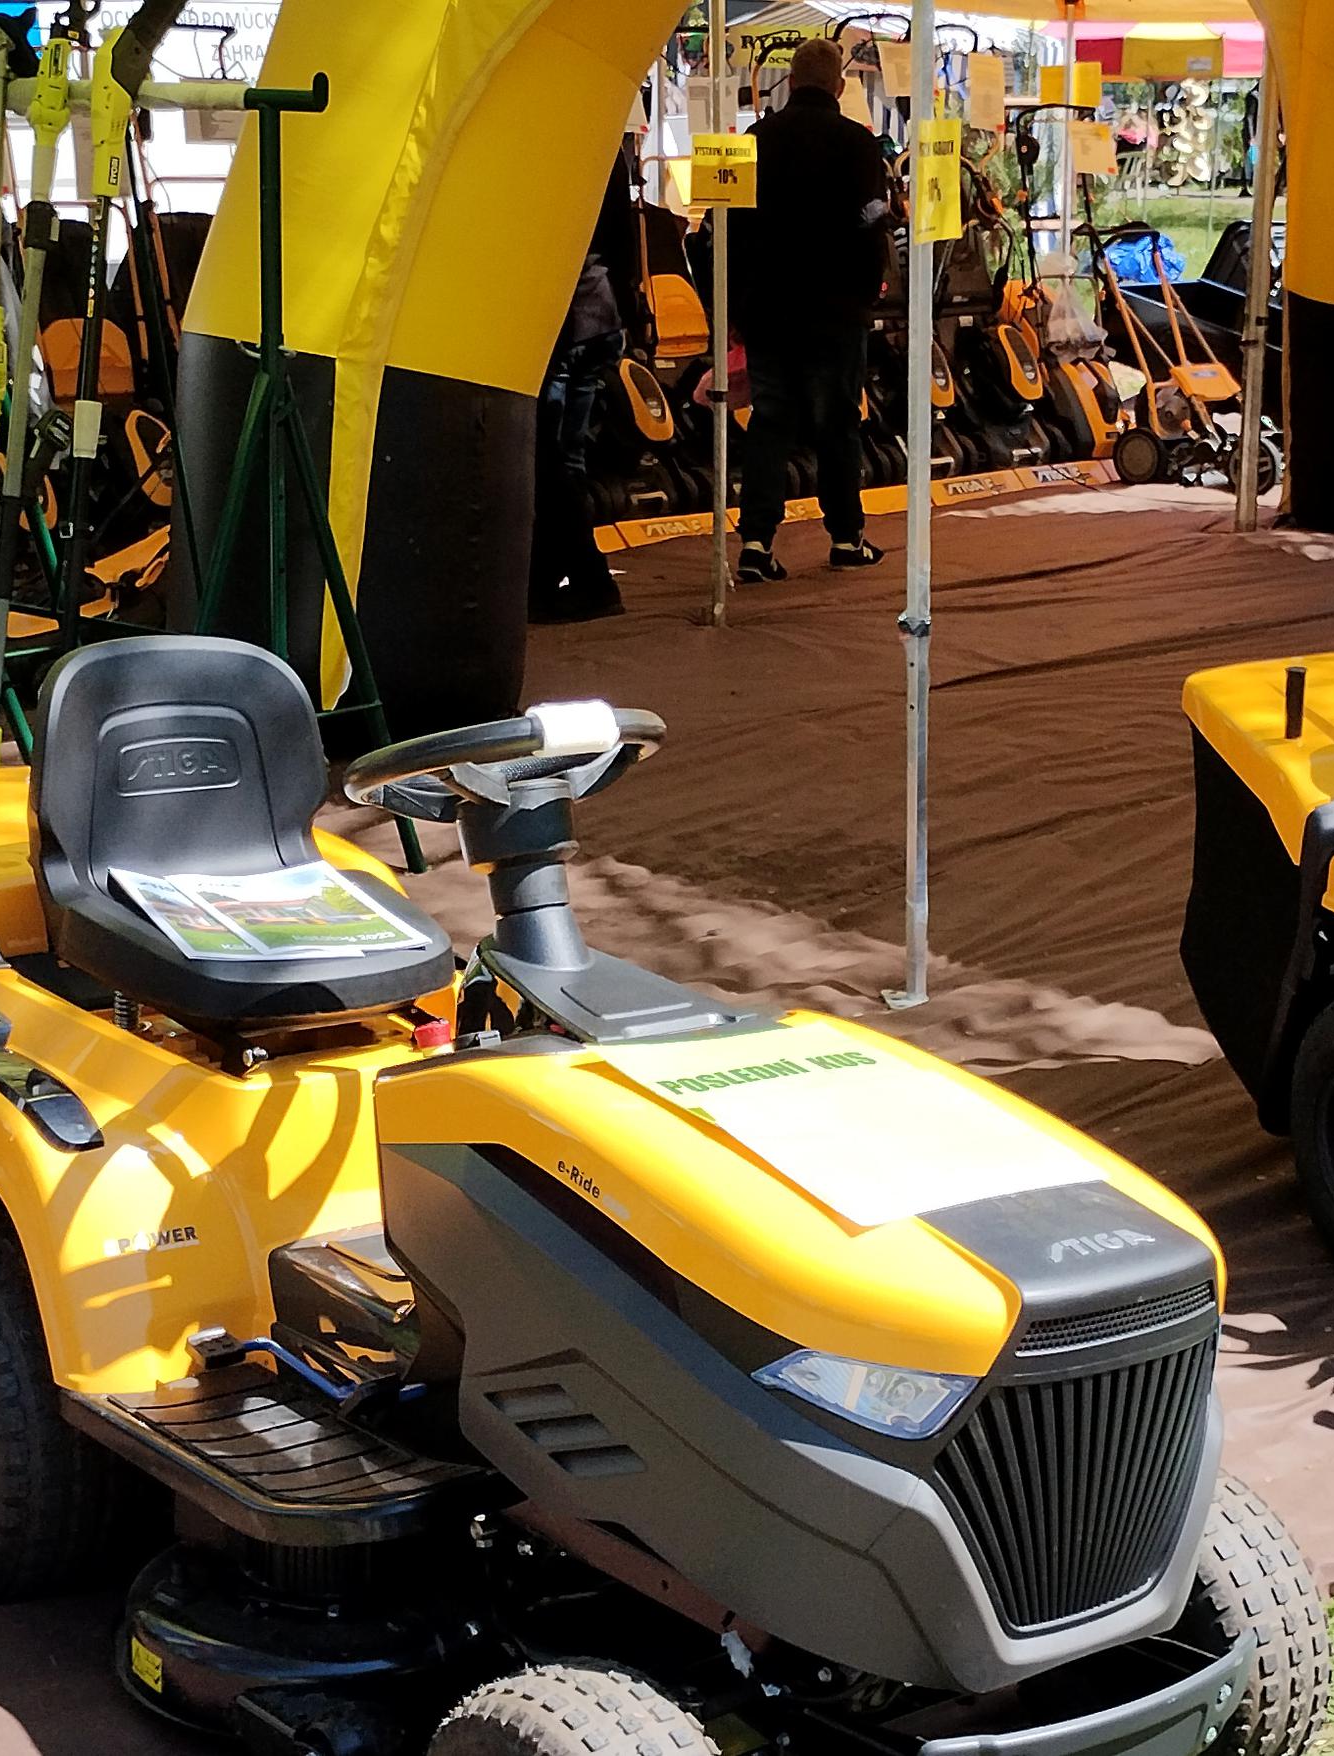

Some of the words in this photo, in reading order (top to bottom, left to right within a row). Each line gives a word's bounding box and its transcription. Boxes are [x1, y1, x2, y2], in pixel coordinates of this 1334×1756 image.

[713, 169, 738, 184] -10%
[656, 1058, 810, 1095] POSLEDNÍ
[805, 1052, 877, 1070] KUS
[557, 1160, 600, 1199] e-Ride
[1051, 1229, 1156, 1262] STIGA
